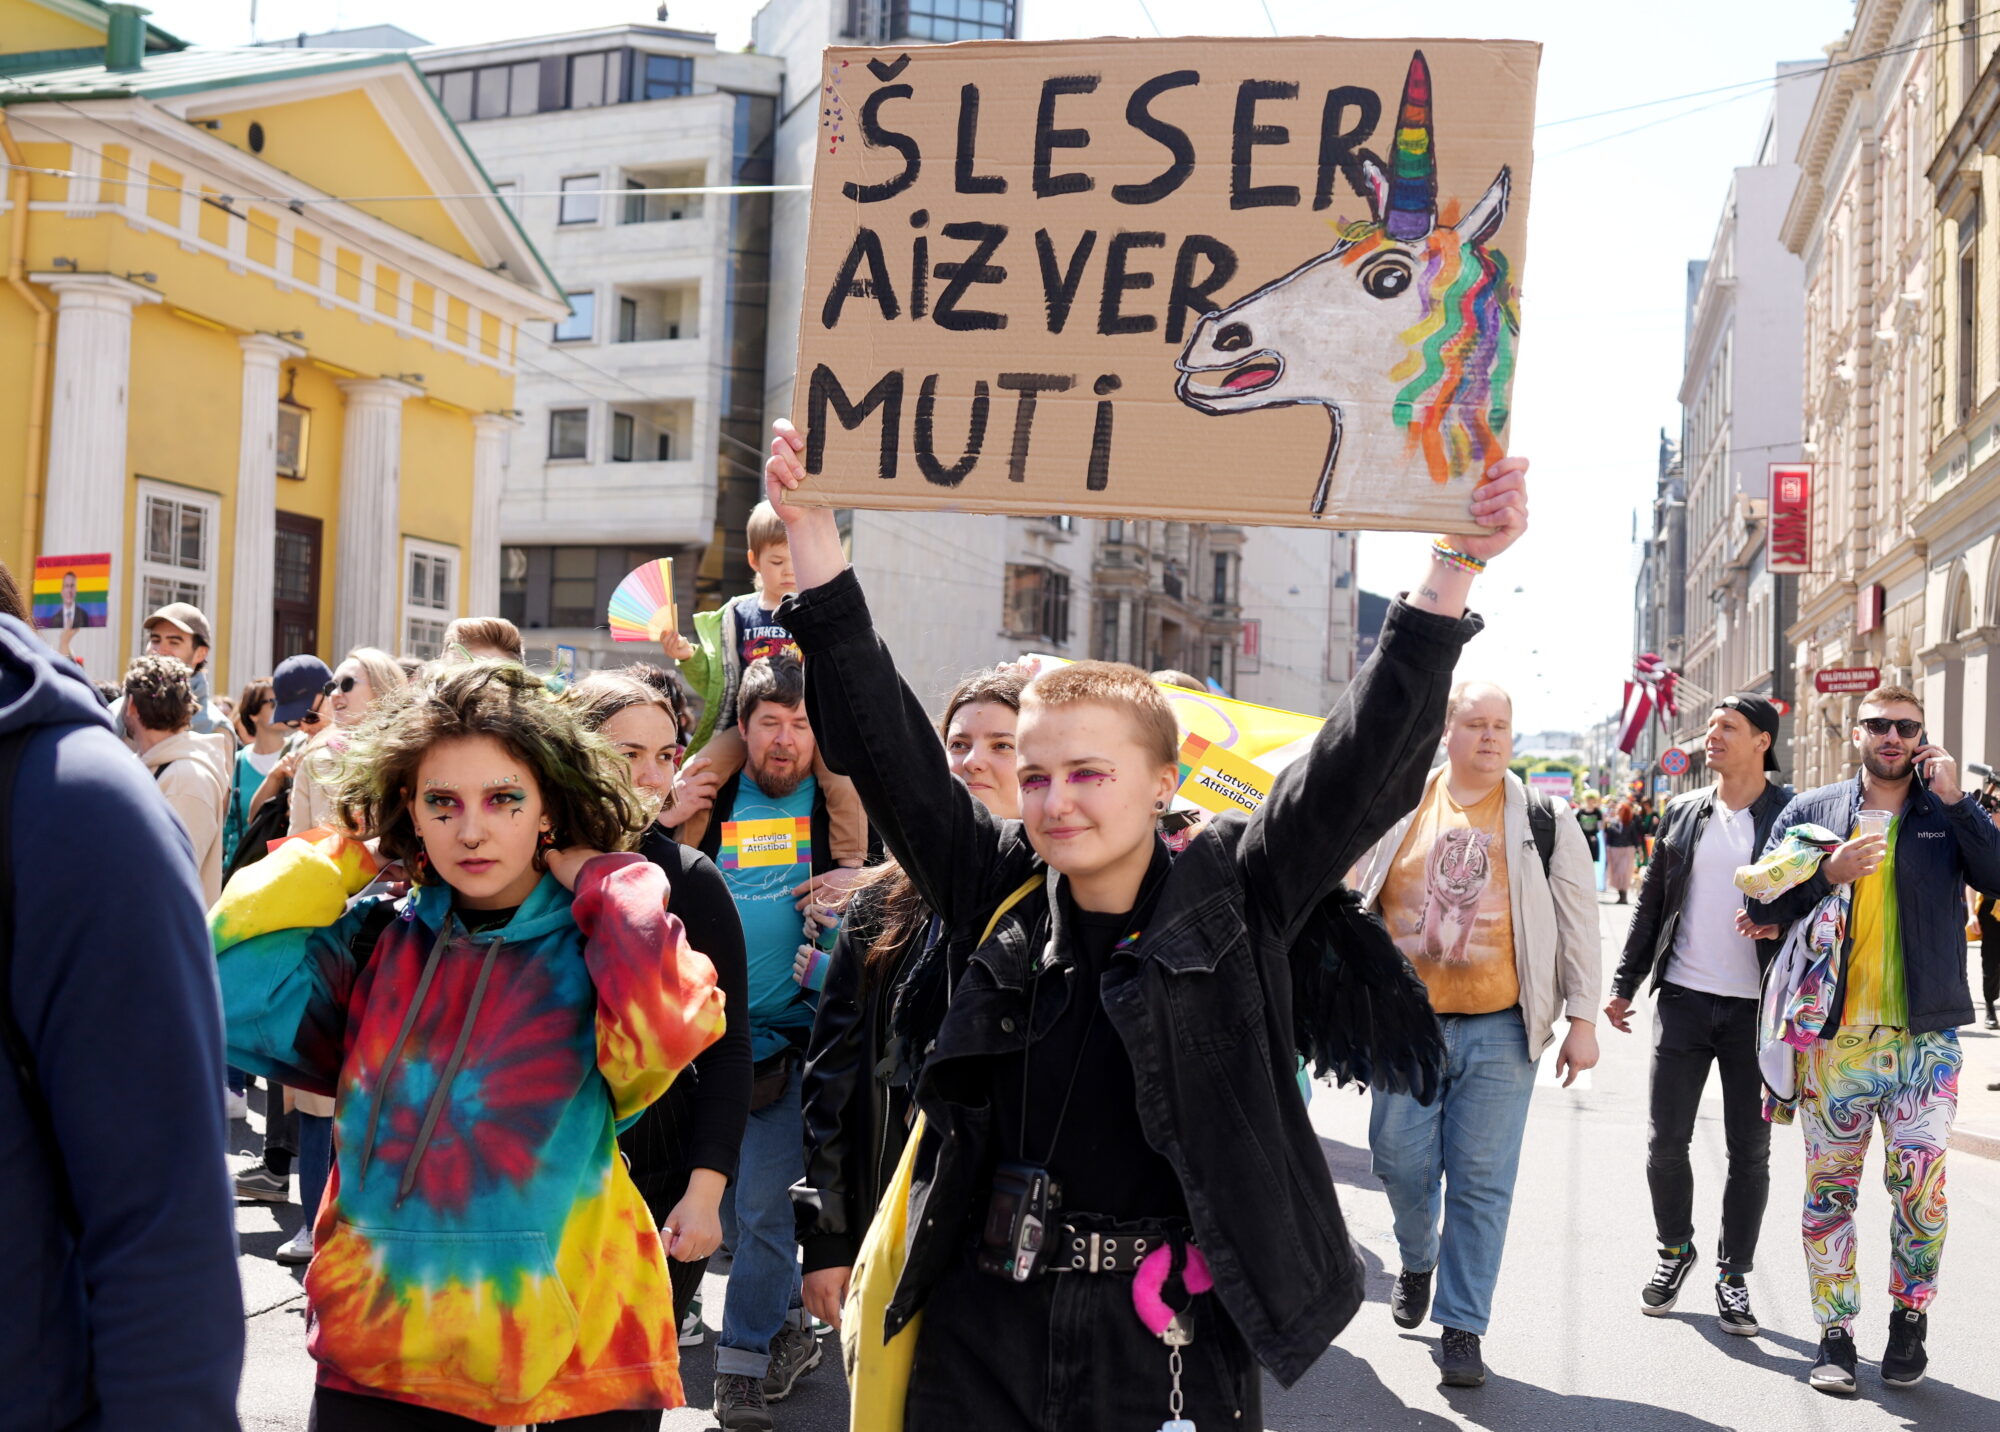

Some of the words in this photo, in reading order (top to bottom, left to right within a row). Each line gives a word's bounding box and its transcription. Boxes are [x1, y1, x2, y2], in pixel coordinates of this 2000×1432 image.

[842, 53, 1387, 211] ŠLESER
[752, 626, 786, 638] TAKES
[1828, 681, 1868, 691] EXCHANGE
[1216, 769, 1265, 801] Latvijas
[752, 832, 788, 843] Latvijas
